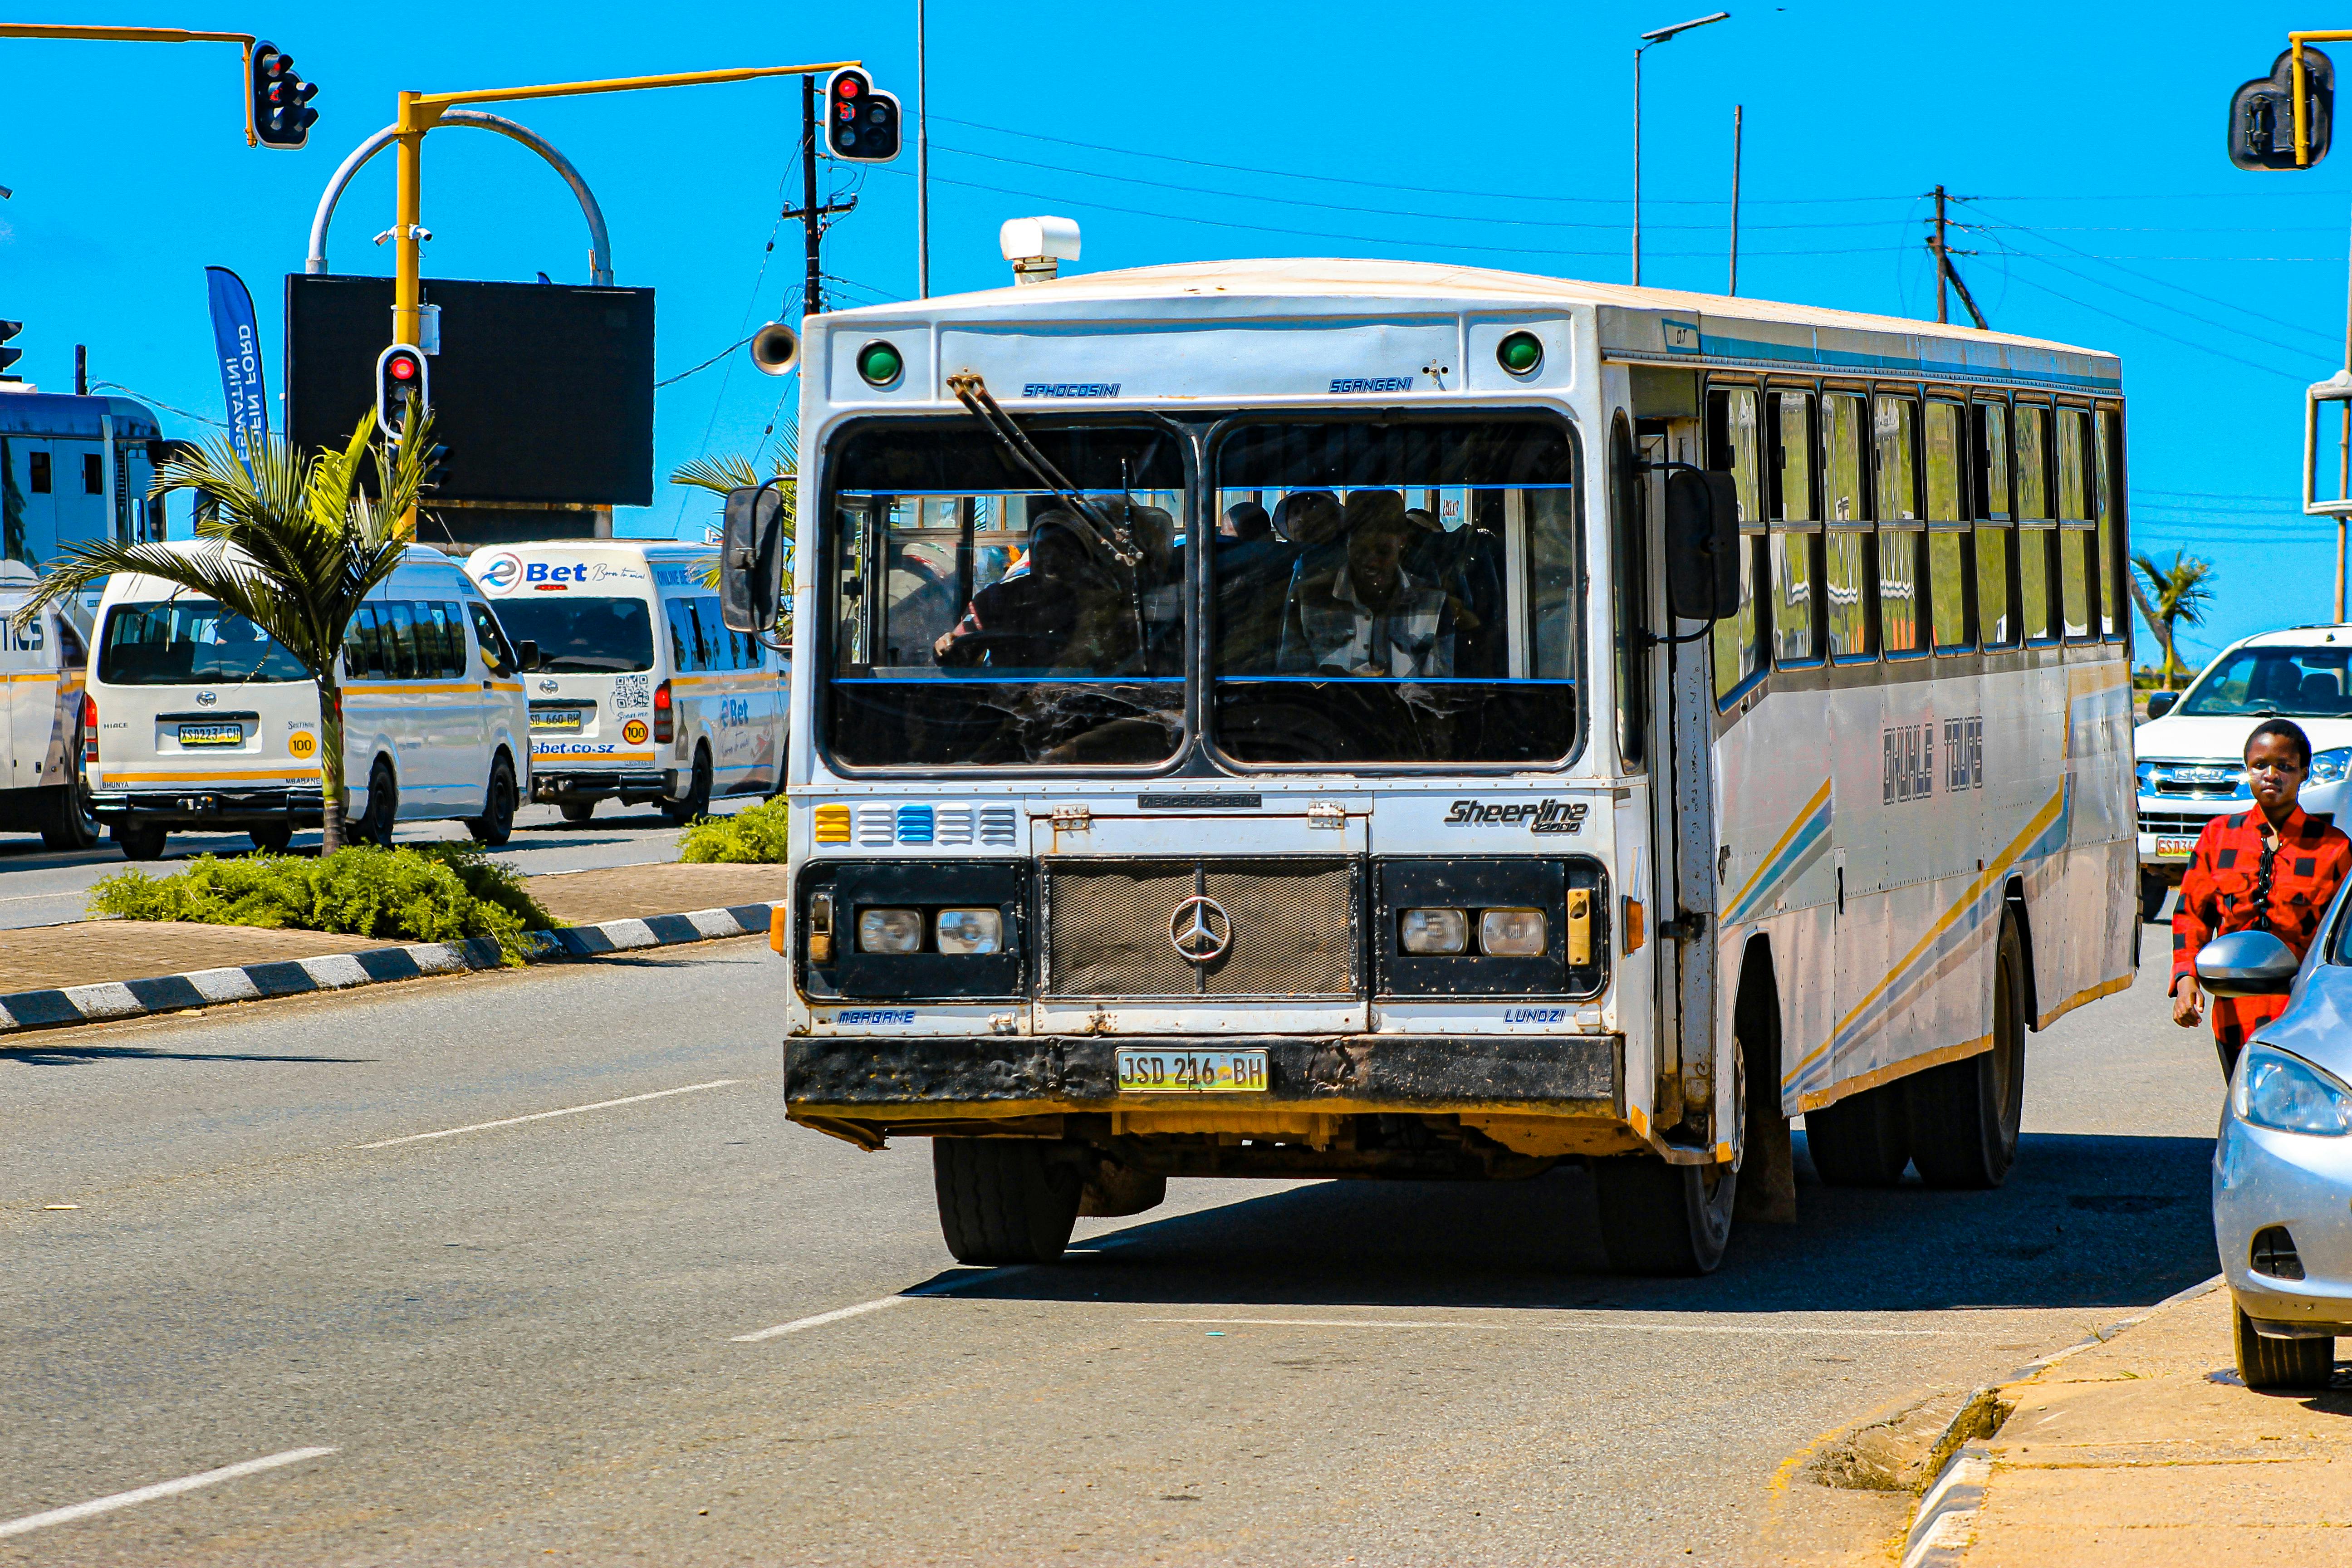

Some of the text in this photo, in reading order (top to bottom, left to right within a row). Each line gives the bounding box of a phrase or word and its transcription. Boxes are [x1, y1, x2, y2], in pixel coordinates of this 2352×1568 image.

[1021, 383, 1122, 398] SPHOCOSINI
[1329, 377, 1414, 393] SGANGENI
[546, 714, 564, 725] 660
[567, 714, 579, 725] BH
[226, 727, 240, 740] CH
[627, 727, 645, 738] 100
[293, 739, 312, 751] 100
[532, 742, 615, 754] ebet.co.sz
[1443, 798, 1588, 823] Sheerline
[2158, 839, 2197, 854] GSD34
[838, 1010, 916, 1025] MBABANE
[1503, 1009, 1567, 1024] LUNDZI
[1121, 1057, 1261, 1085] JSD 216 BH
